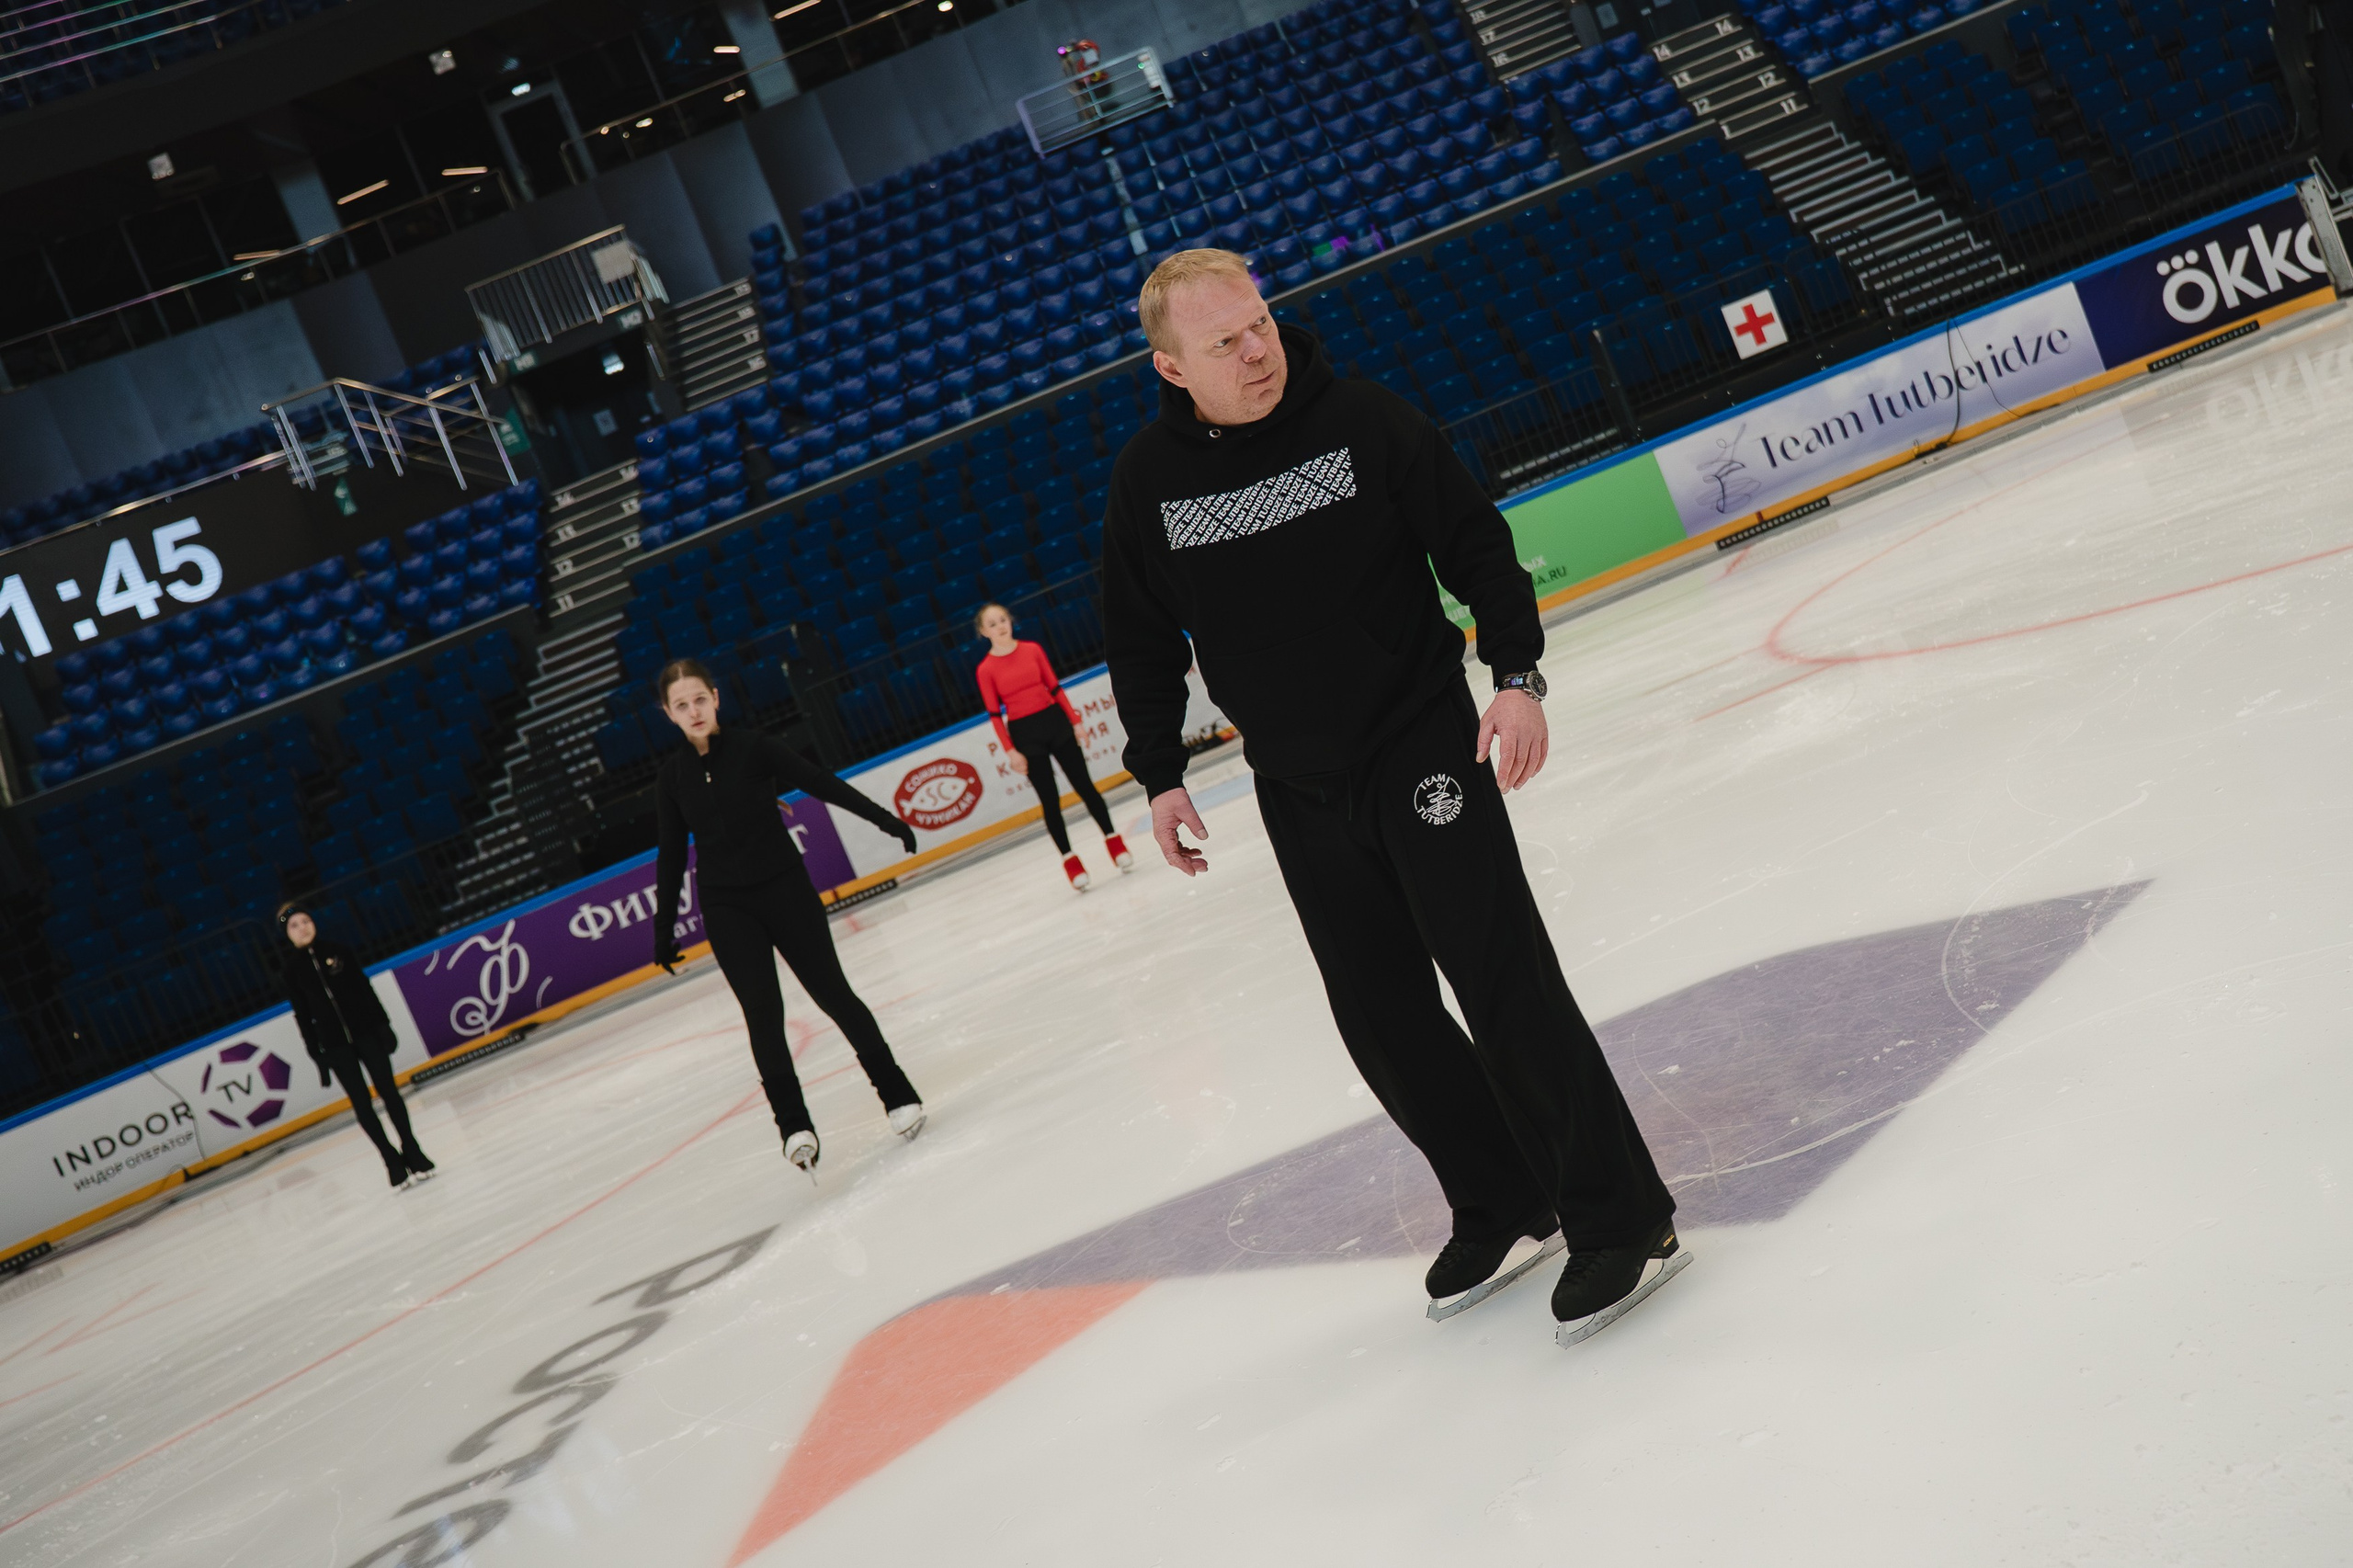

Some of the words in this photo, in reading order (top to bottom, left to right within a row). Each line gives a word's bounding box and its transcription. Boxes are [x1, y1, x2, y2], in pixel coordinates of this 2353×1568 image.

[1715, 19, 1733, 37] 14
[1653, 43, 1671, 62] 14
[1735, 45, 1756, 62] 13
[1758, 71, 1776, 89] 12
[1692, 97, 1711, 116] 12
[1780, 97, 1797, 115] 11
[1755, 410, 1864, 469] Team
[1863, 329, 2070, 426] Tutberidze
[1313, 460, 1331, 483] TEAM
[1328, 470, 1347, 492] TEAM
[1279, 472, 1296, 494] TEAM
[1294, 480, 1311, 502] TEAM
[1214, 499, 1233, 520] TEAM
[1308, 487, 1326, 510] TEAM
[1181, 503, 1199, 523] TEAM
[1229, 509, 1246, 530] TEAM
[1236, 485, 1270, 536] TUTBERIDZE
[1195, 513, 1212, 534] TEAM
[0, 516, 223, 657] 1:45
[1419, 773, 1446, 790] TEAM
[1416, 793, 1463, 825] TUTBERIDZE
[216, 1073, 253, 1104] TV
[52, 1101, 194, 1177] INDOOR
[73, 1162, 124, 1192] ИНДОР
[124, 1131, 194, 1170] ОПЕРАТОР
